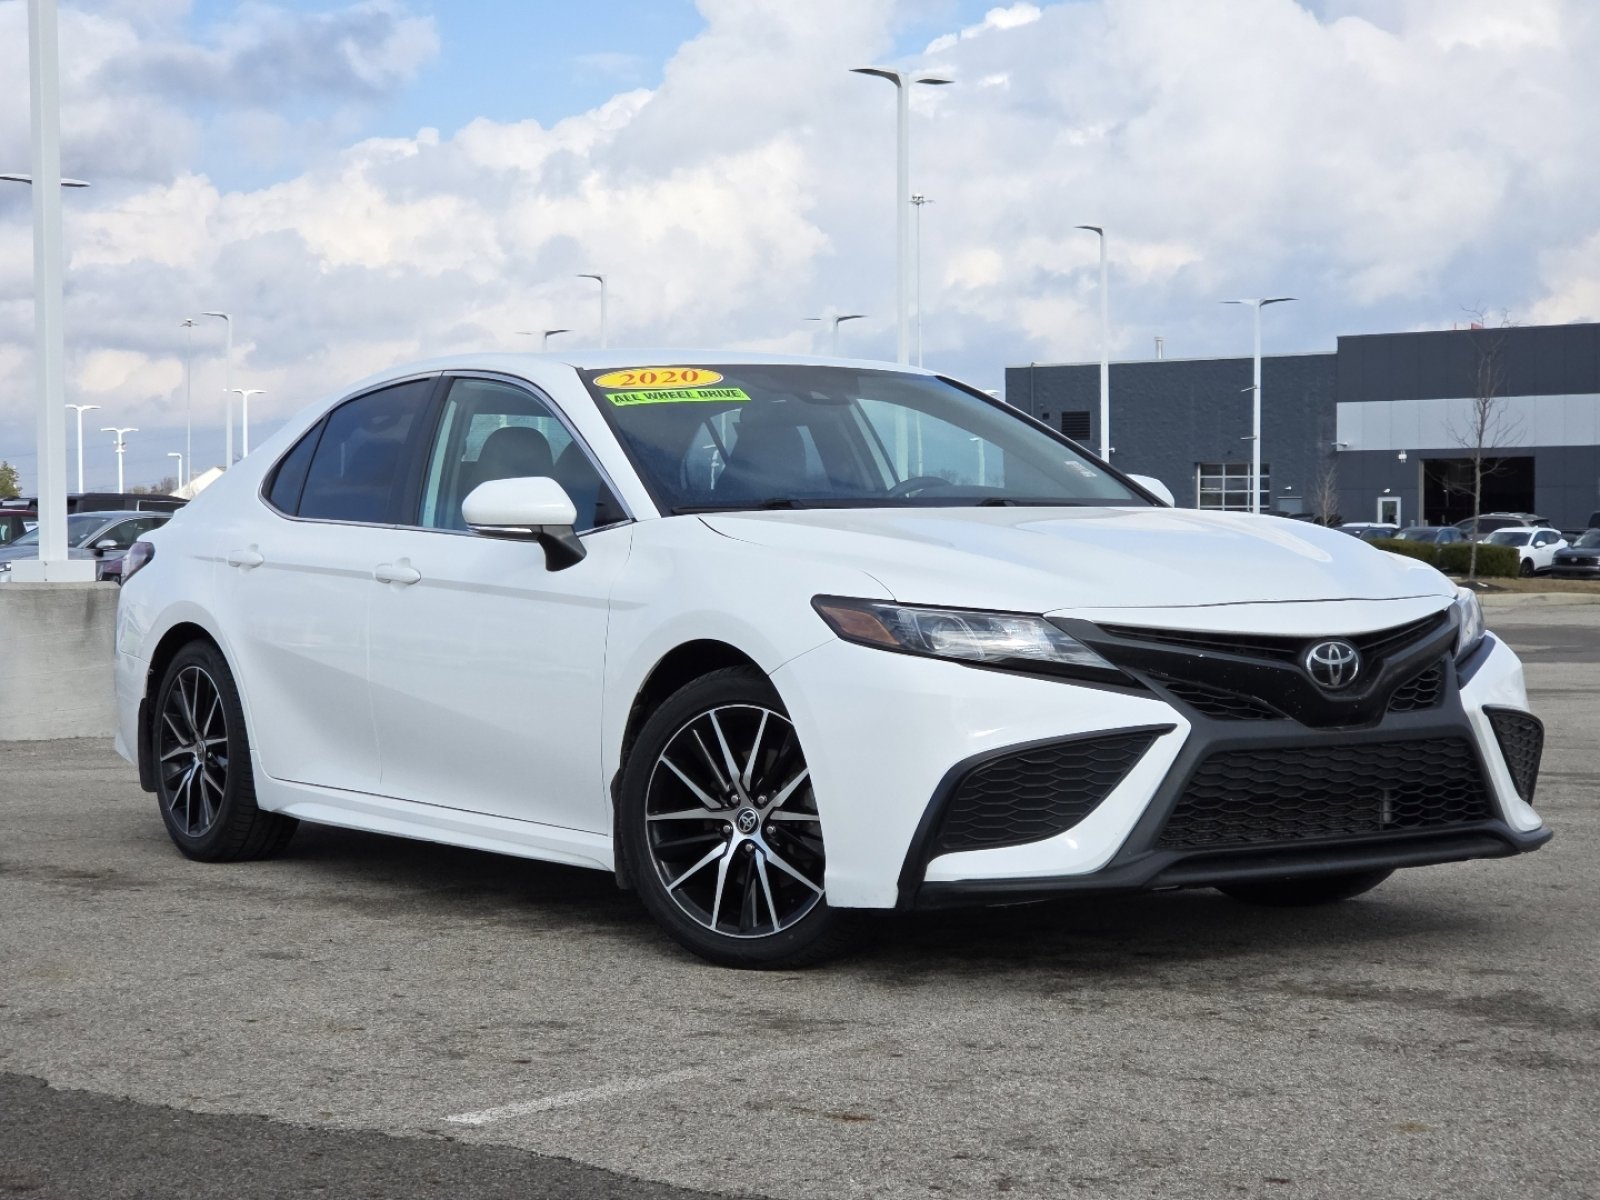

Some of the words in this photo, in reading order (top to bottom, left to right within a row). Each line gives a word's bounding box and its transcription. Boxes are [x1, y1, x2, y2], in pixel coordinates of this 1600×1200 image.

[620, 370, 699, 386] 2020
[613, 393, 641, 403] ALL
[643, 390, 693, 400] WHEEL
[697, 389, 742, 398] DRIVE
